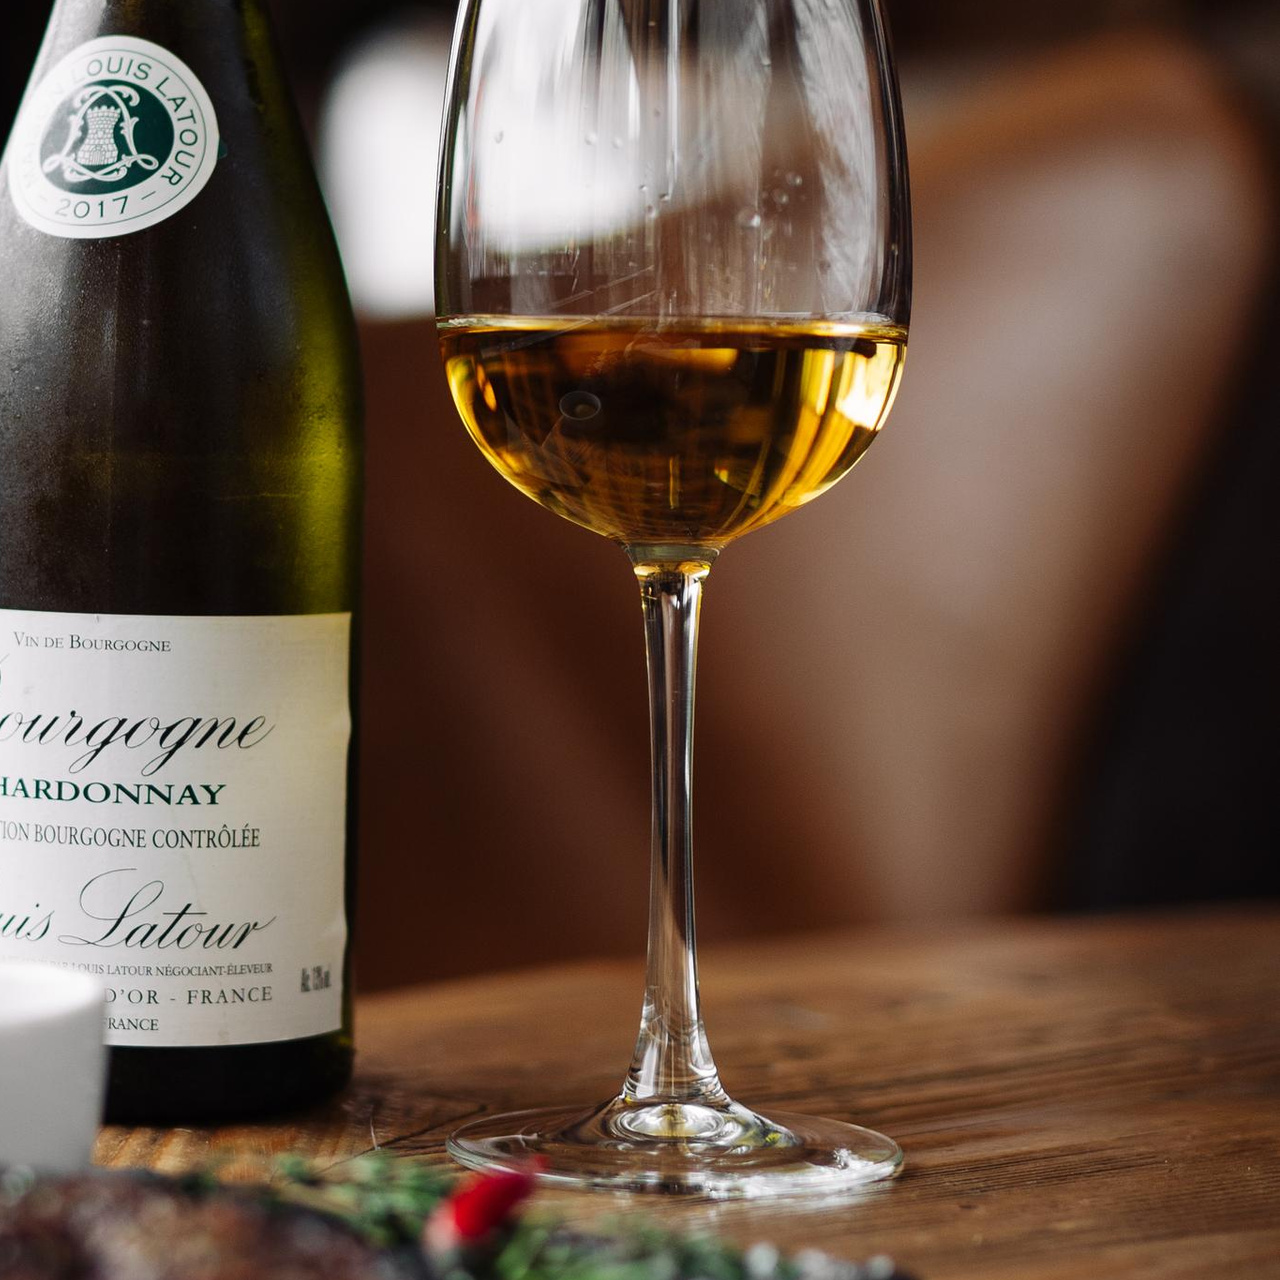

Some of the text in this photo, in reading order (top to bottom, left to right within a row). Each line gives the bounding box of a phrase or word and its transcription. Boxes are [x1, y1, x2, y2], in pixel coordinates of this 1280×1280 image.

[155, 76, 199, 187] LATOUR
[55, 195, 129, 219] 2017
[34, 824, 146, 848] BOURGOGNE
[152, 823, 260, 849] CONTRÔLÉE
[58, 868, 277, 949] Latour
[107, 963, 153, 977] LATOUR
[186, 985, 273, 1005] FRANCE
